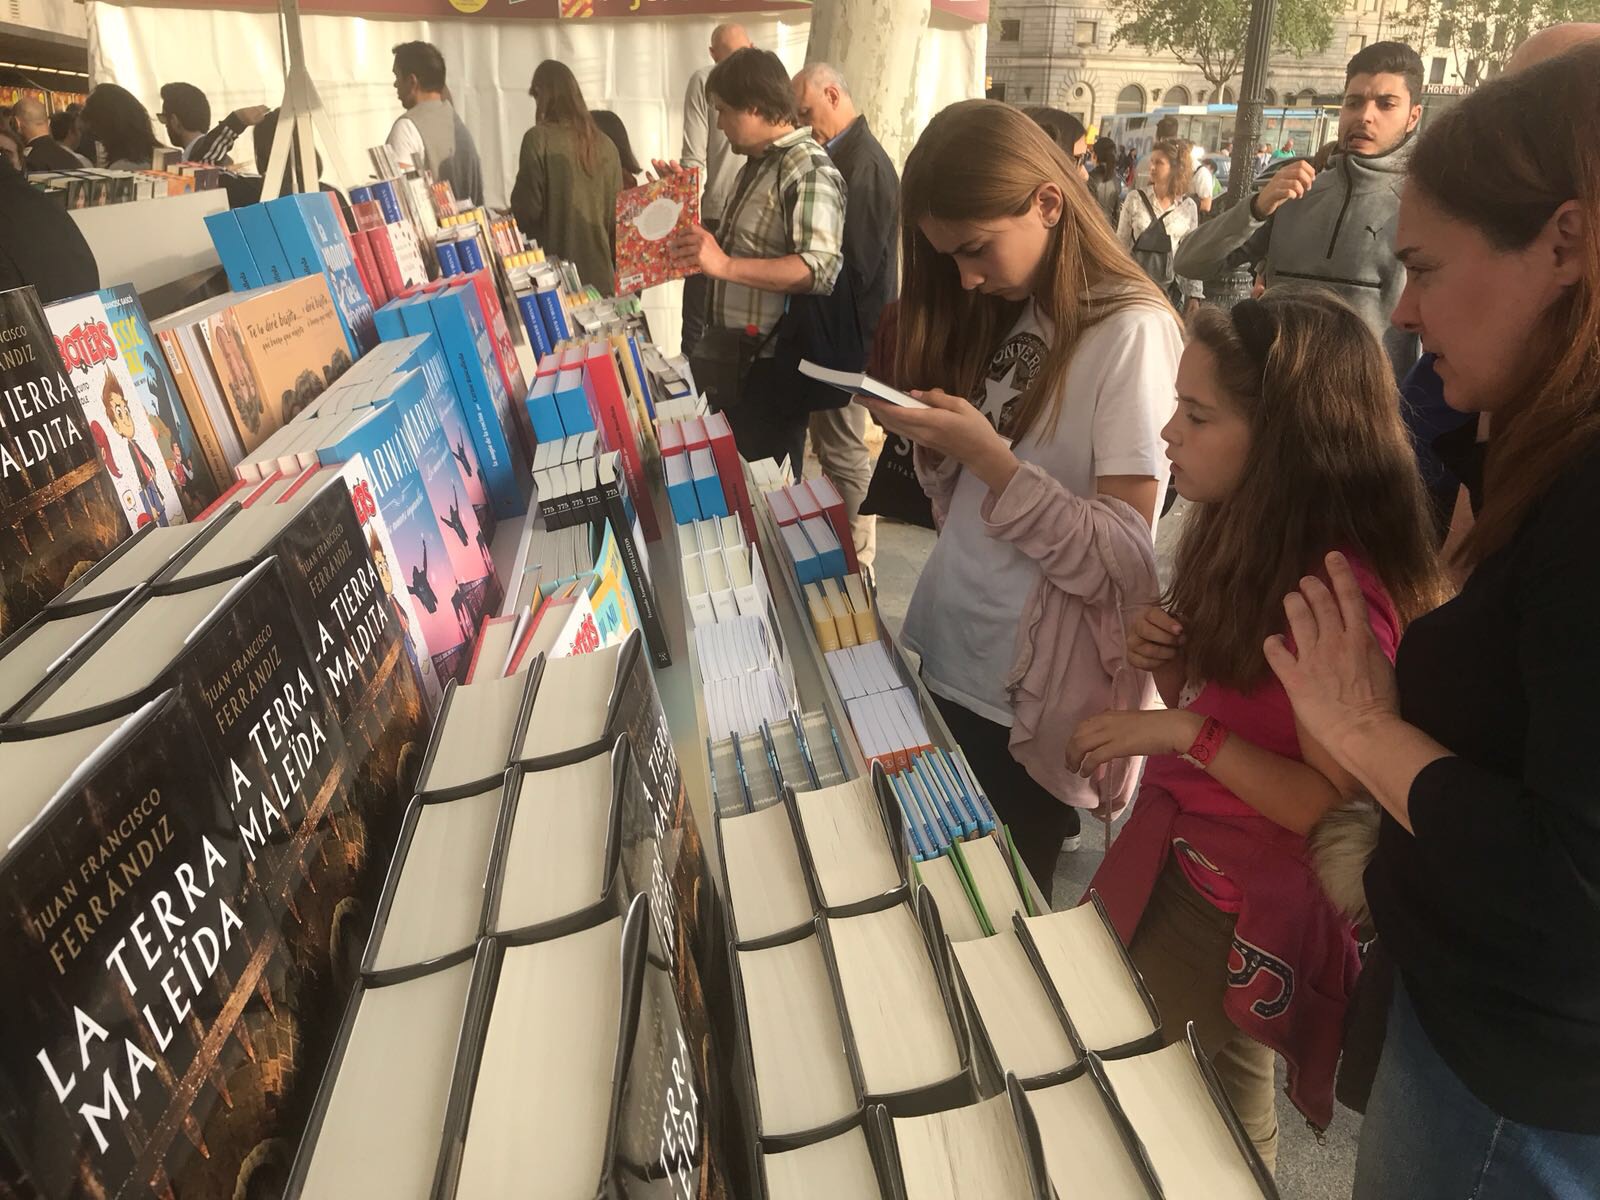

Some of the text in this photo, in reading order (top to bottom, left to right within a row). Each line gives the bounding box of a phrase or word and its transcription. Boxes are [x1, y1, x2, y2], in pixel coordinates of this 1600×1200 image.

[1427, 84, 1453, 94] Hotel
[0, 371, 73, 428] IERRA
[990, 343, 1041, 390] ONVERS
[301, 523, 344, 579] JUAN FRANCISCO
[309, 540, 353, 599] FERRÁNDIZ
[315, 557, 379, 663] A TIERRA
[325, 599, 389, 698] MALDITA
[205, 624, 273, 709] JUAN FRANCISCO
[215, 645, 282, 735] FERRÁNDIZ
[229, 667, 315, 811] A TERRA
[238, 715, 327, 862] MALEÏDA
[33, 788, 162, 940] JUAN FRANCISCO
[49, 813, 175, 976] FERRÁNDIZ
[36, 834, 227, 1103] LA TERRA
[78, 897, 243, 1154] MALEÏDA
[660, 1027, 687, 1188] TERRA
